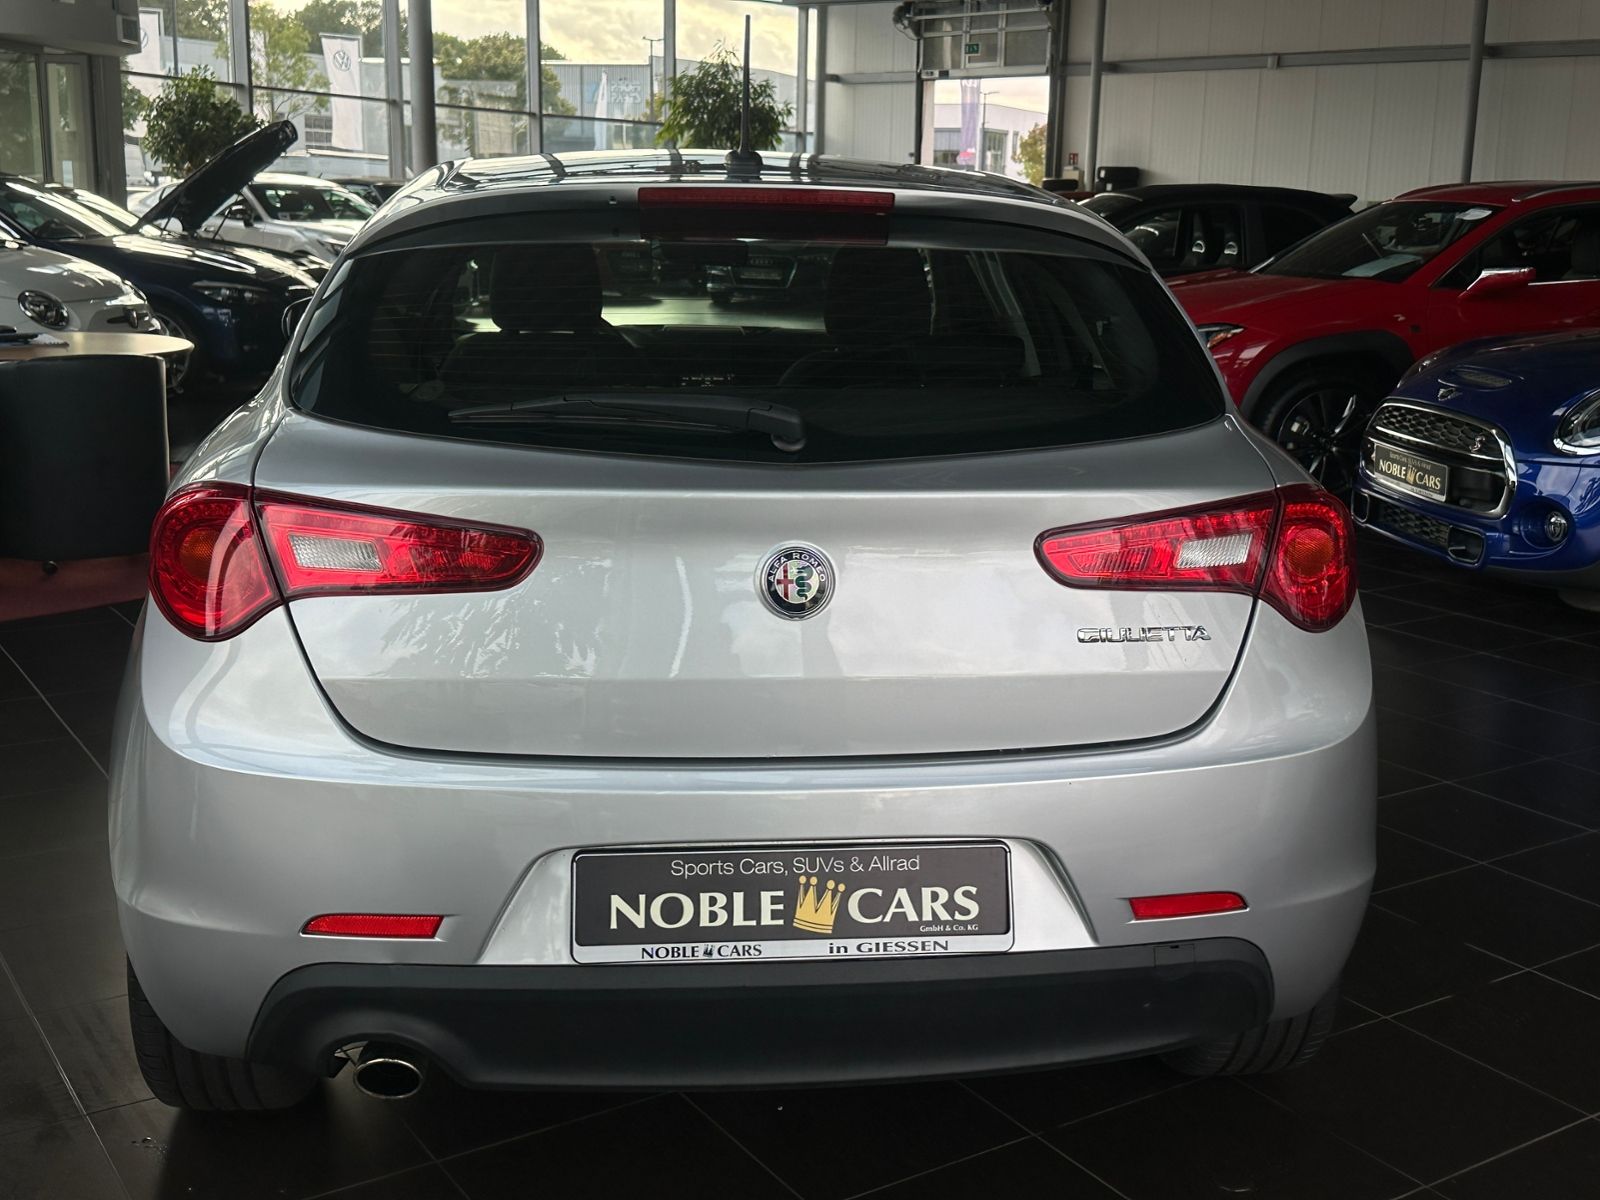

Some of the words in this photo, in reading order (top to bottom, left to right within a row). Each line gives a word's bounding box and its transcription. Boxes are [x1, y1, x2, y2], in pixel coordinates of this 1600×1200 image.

[1379, 459, 1406, 479] NOBLE
[1416, 471, 1441, 490] CARS
[768, 556, 788, 582] ALFA
[792, 552, 826, 582] ROMEO
[1077, 625, 1211, 643] GIULIETTA
[671, 859, 734, 880] Sports
[739, 858, 788, 876] Cars,
[792, 856, 845, 873] SUVs
[849, 856, 864, 872] &
[868, 855, 920, 871] Allrad
[610, 890, 785, 930] NOBLE
[847, 885, 980, 924] CARS
[967, 923, 979, 931] KG
[641, 945, 700, 959] NOBLE
[717, 944, 762, 957] CARS
[829, 942, 848, 954] in
[856, 940, 949, 953] GIESSEN
